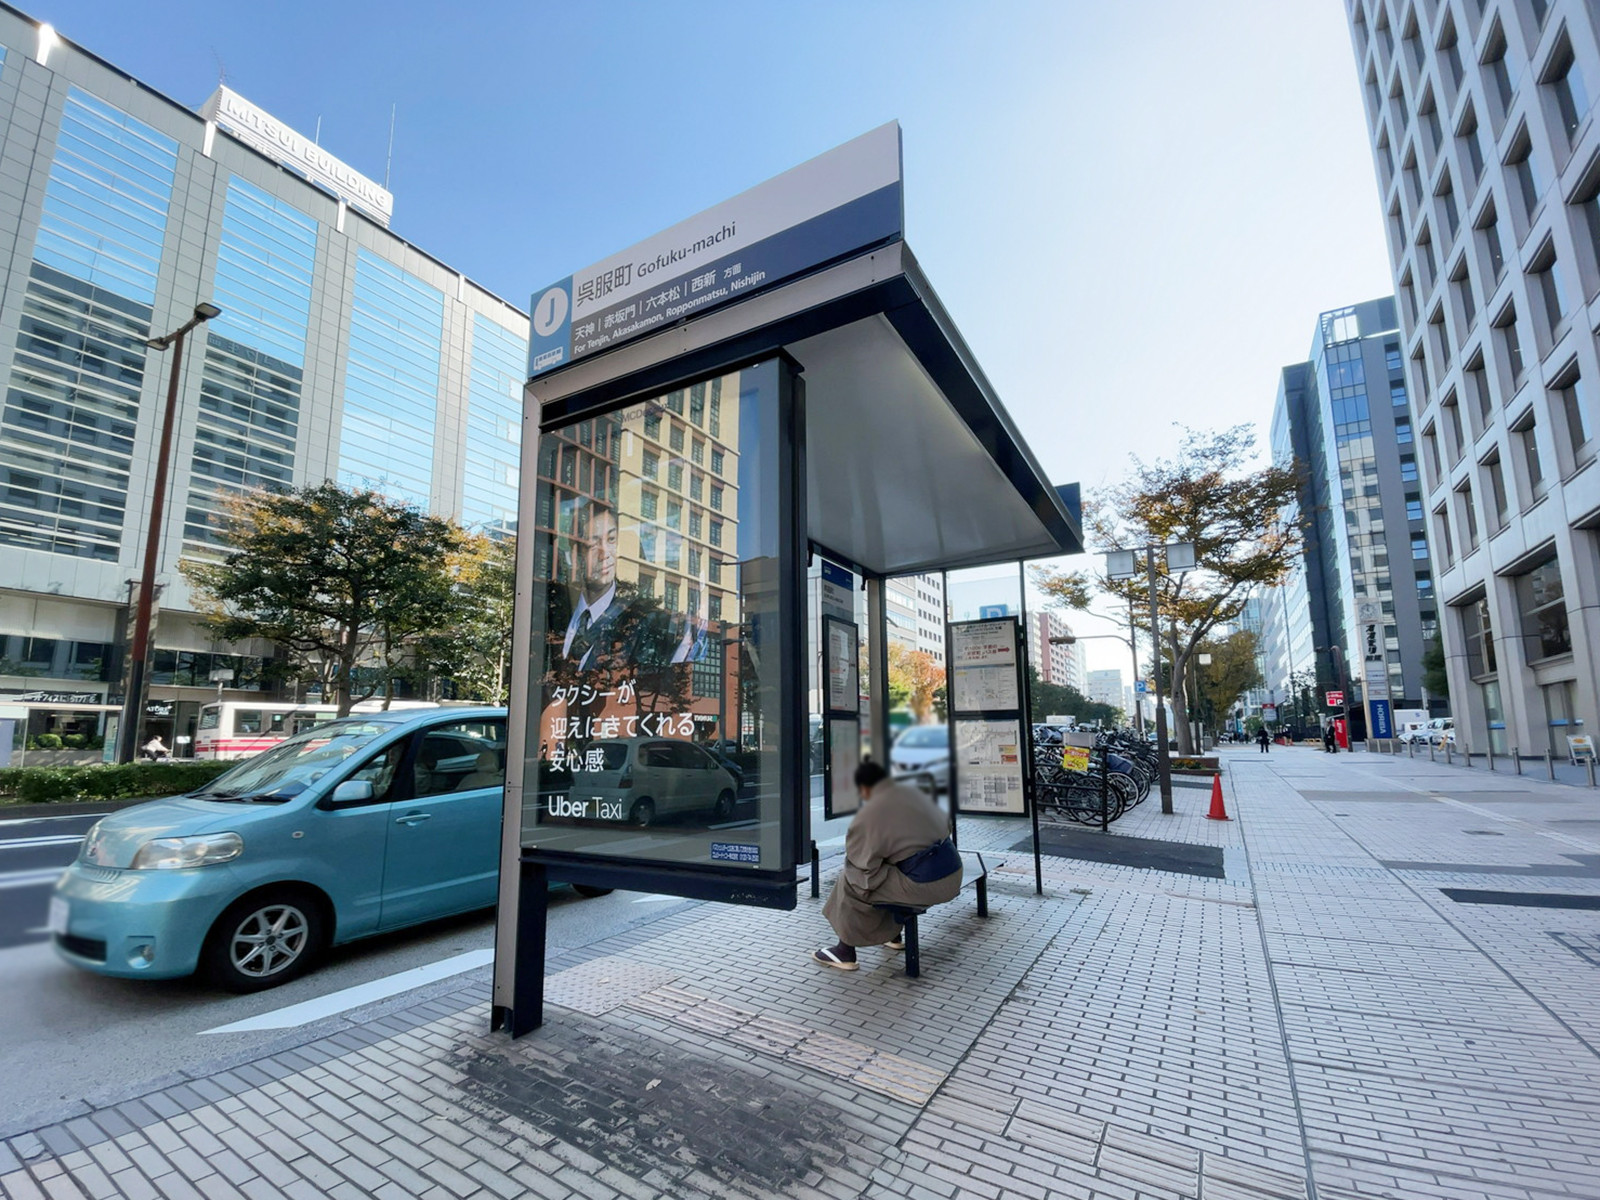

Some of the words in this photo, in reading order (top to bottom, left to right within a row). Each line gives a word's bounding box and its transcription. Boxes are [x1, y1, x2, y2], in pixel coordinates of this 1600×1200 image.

[227, 98, 297, 152] MITSUI
[304, 146, 387, 208] BUILDING
[577, 262, 633, 307] 呉服町
[637, 221, 736, 278] Gofuku-machi
[545, 297, 555, 327] J
[574, 340, 586, 354] For
[587, 332, 611, 351] Tenjin,
[613, 313, 664, 339] Akasakamon,
[666, 288, 728, 317] Ropponmatsu,
[731, 269, 766, 292] Nishijin
[575, 321, 595, 341] 天神
[604, 304, 636, 328] 赤坂門
[645, 285, 681, 312] 六本松
[691, 269, 716, 293] 西新
[723, 262, 742, 279] 方面
[552, 679, 637, 707] タクシーが
[1136, 682, 1144, 692] P
[550, 712, 695, 739] 迎えにきてくれる
[549, 748, 605, 773] 安心感
[548, 796, 589, 818] Uber
[592, 797, 622, 819] Taxi
